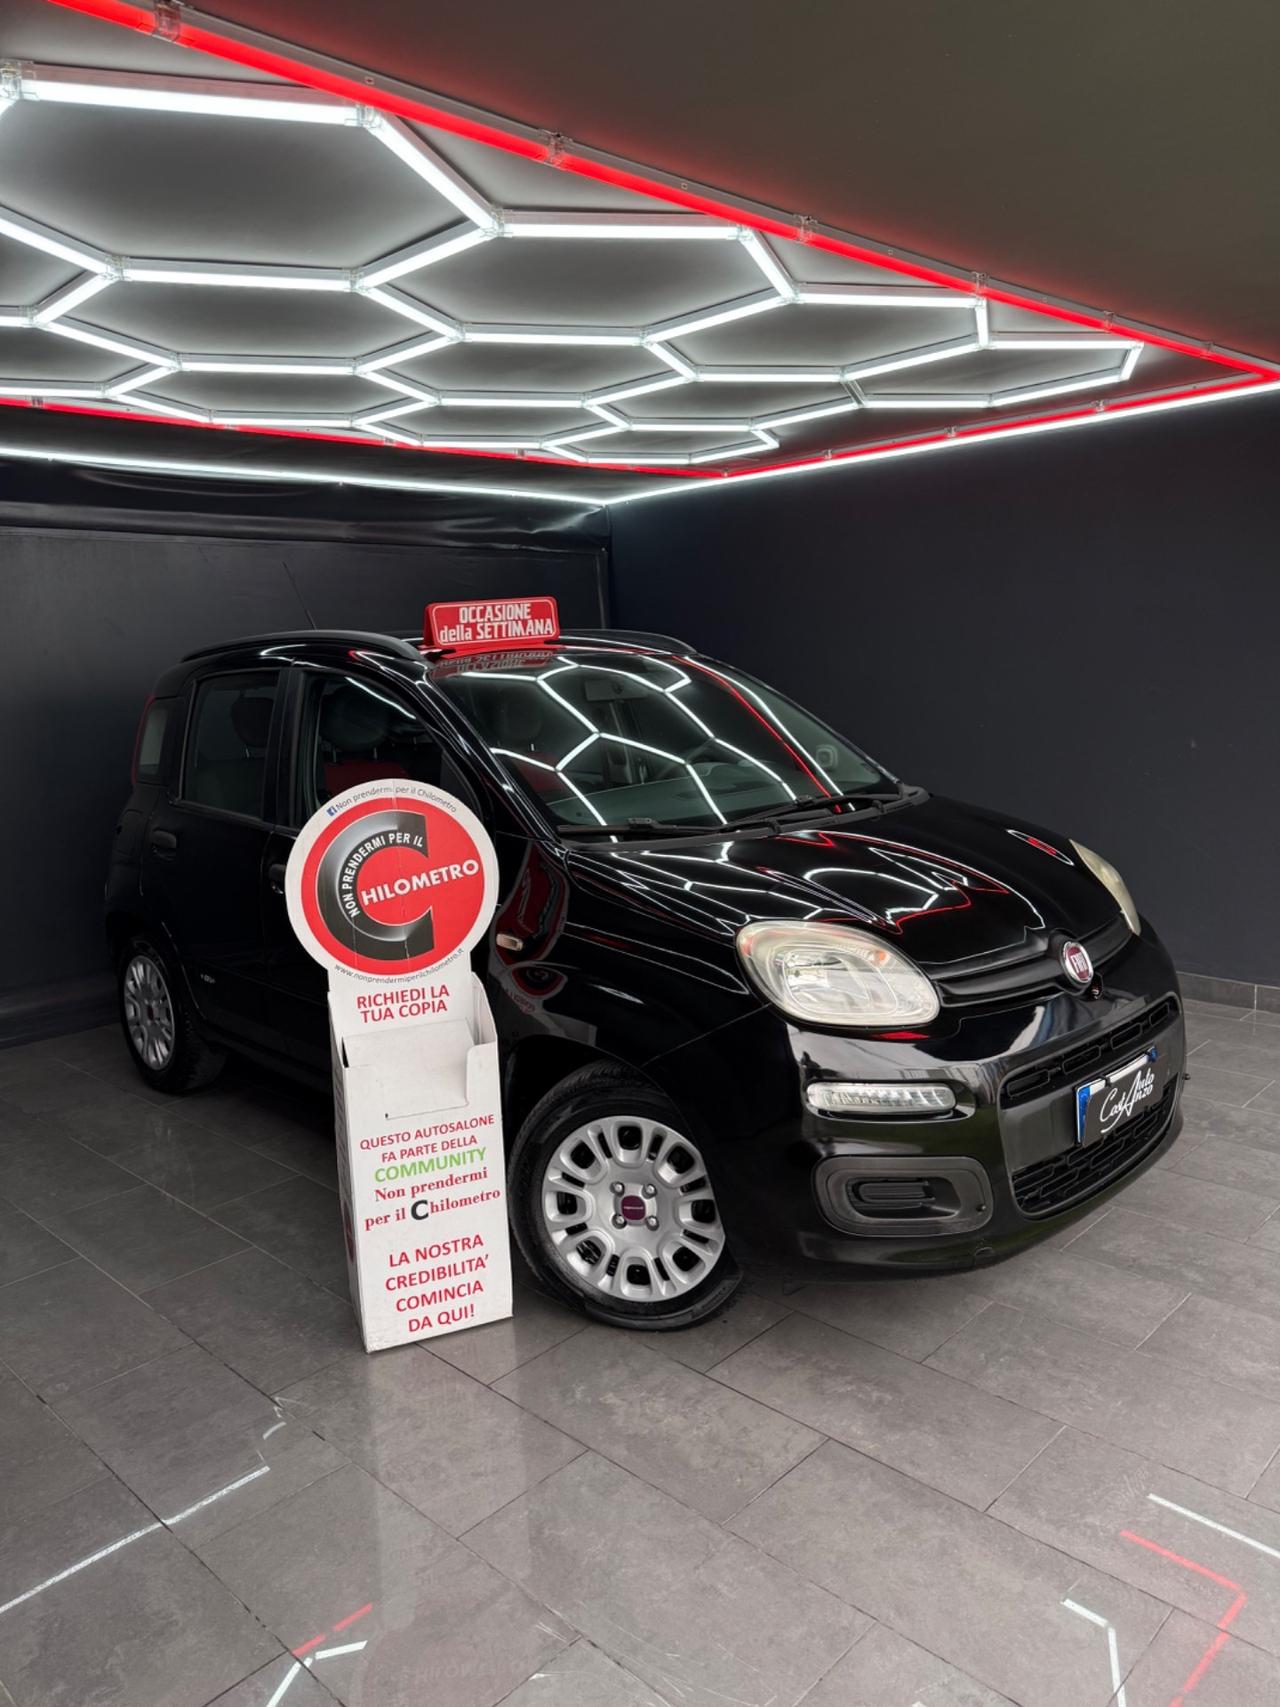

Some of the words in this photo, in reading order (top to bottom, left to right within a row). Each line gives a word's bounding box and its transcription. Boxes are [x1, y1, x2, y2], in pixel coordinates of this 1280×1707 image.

[459, 603, 531, 623] OCCASIONE
[440, 625, 472, 643] della
[476, 619, 553, 640] SETTIMANA
[335, 797, 353, 810] Non
[395, 787, 410, 797] per
[417, 789, 457, 813] Chilometro
[388, 832, 411, 844] PER
[413, 835, 424, 848] IL
[342, 835, 386, 890] PRENDERMI
[342, 892, 360, 919] NON
[357, 988, 425, 1009] RICHIEDI
[431, 984, 450, 998] LA
[361, 1007, 394, 1023] TUA
[399, 1000, 447, 1017] COPIA
[360, 1131, 411, 1150] QUESTO
[414, 1114, 495, 1139] AUTOSALONE
[381, 1152, 397, 1163] FA
[400, 1143, 438, 1159] PARTE
[441, 1135, 478, 1151] DELLA
[374, 1147, 487, 1182] COMMUNITY
[374, 1187, 406, 1202] Non
[411, 1167, 488, 1198] prendermi
[364, 1214, 391, 1231] per
[395, 1208, 406, 1221] il
[410, 1189, 500, 1220] Chilometro
[389, 1252, 410, 1267] LA
[415, 1234, 484, 1262] NOSTRA
[385, 1254, 489, 1291] CREDIBILITA'
[396, 1280, 484, 1312] COMINCIA
[408, 1316, 433, 1332] DA
[437, 1304, 474, 1325] QUI!
